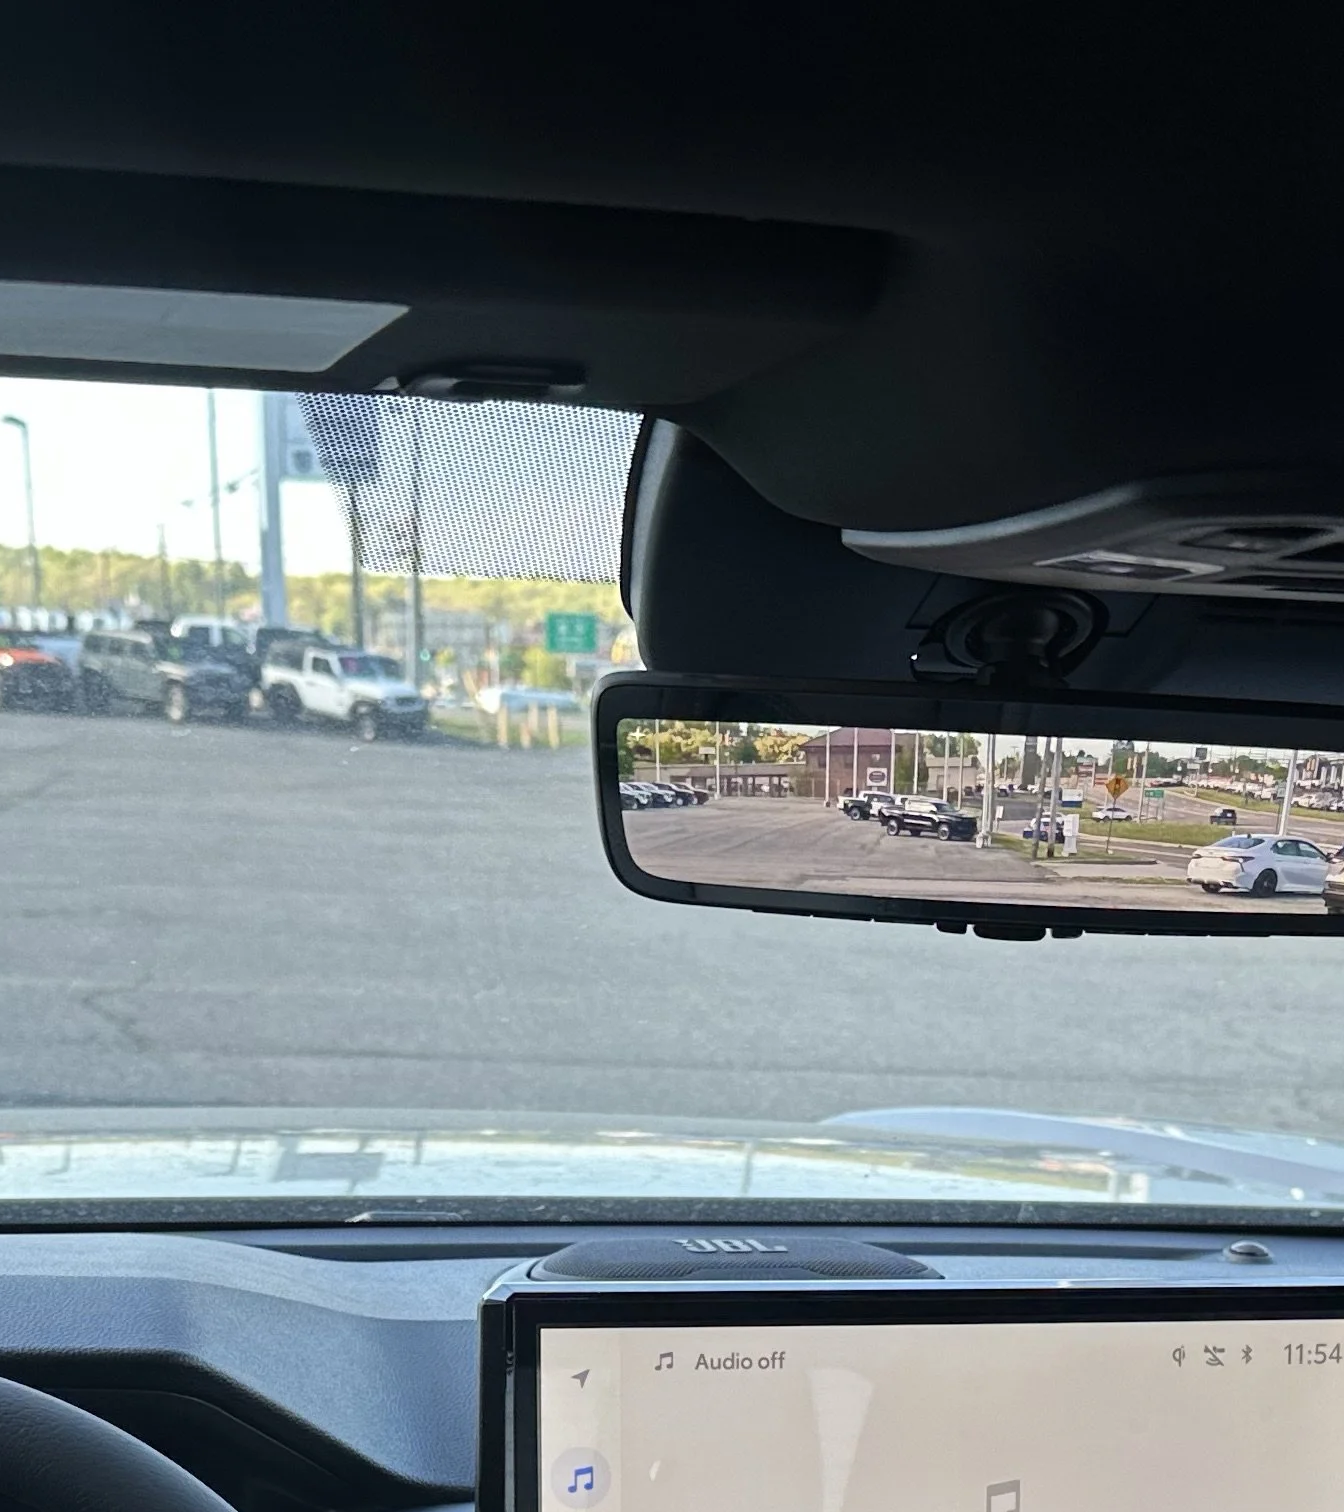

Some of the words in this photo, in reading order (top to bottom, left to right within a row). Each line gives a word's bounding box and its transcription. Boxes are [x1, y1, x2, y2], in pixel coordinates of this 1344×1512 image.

[694, 1352, 753, 1370] Audio
[757, 1351, 786, 1370] off
[1283, 1343, 1343, 1365] 11:54
